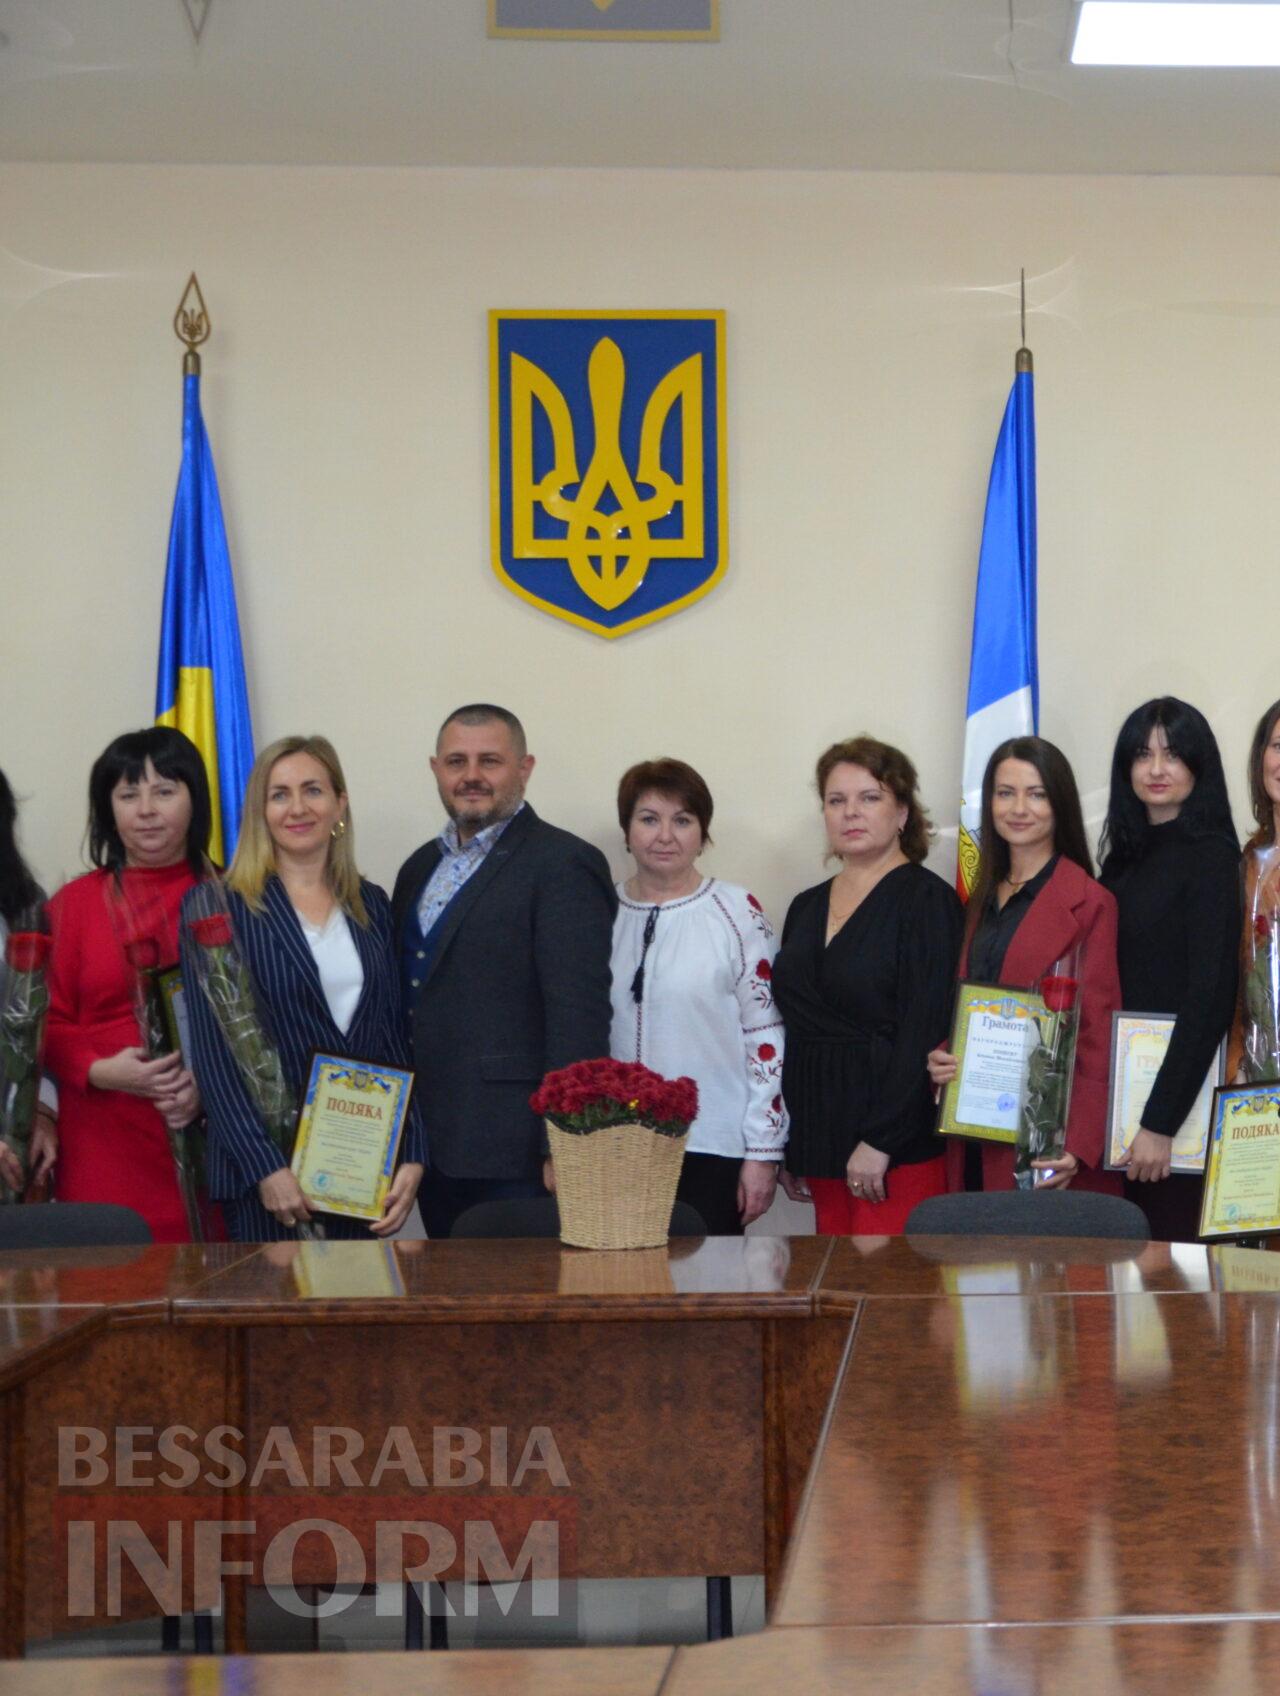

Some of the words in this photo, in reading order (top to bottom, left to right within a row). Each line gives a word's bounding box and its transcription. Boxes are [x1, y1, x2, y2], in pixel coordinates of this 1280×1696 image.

[982, 1015, 1029, 1033] Грамота
[326, 1097, 384, 1121] ПОДЯКА
[1232, 1123, 1280, 1140] ПОДЯКА
